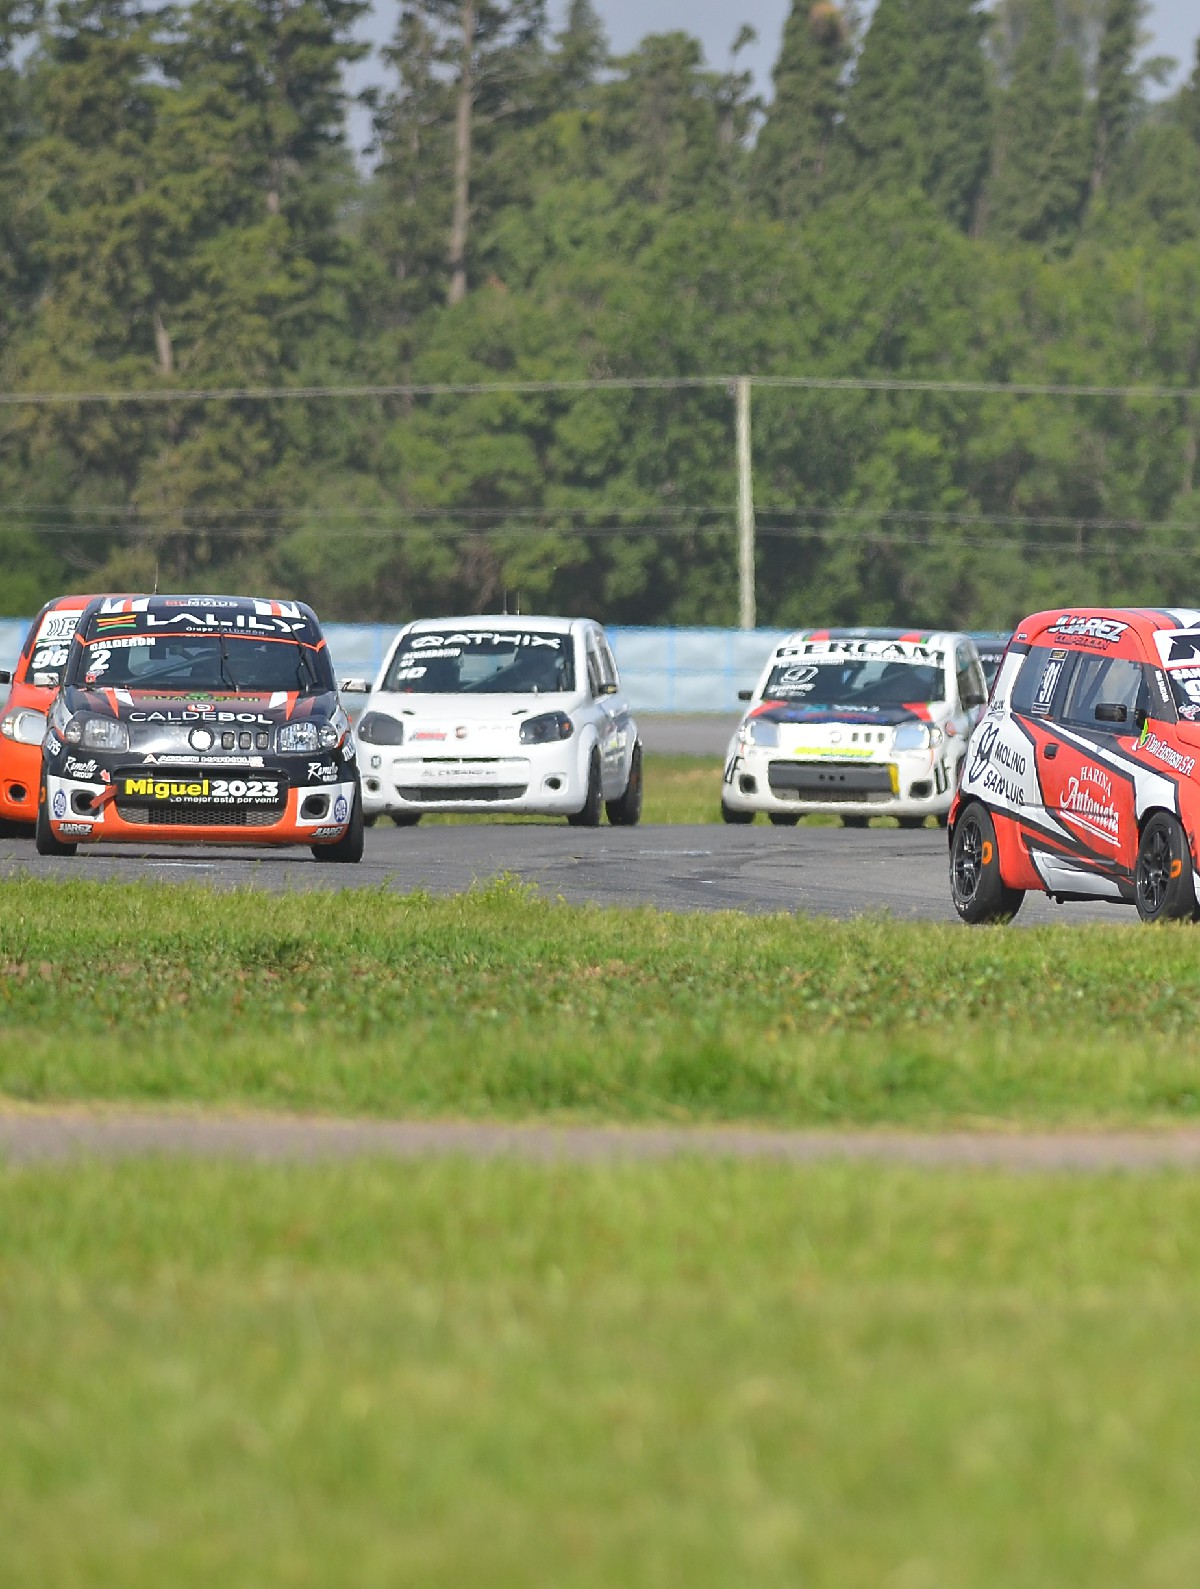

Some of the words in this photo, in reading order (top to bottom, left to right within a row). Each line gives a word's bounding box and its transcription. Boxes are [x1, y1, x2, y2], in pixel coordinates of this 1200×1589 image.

[147, 613, 305, 633] LALILY
[1048, 615, 1129, 643] JUAREZ
[32, 649, 69, 669] 96
[89, 650, 111, 671] 2
[129, 711, 274, 724] CALDEBOL
[994, 741, 1026, 776] MOLINO
[125, 778, 209, 798] Miguel
[211, 780, 279, 797] 2023
[1081, 766, 1112, 797] HARINA
[184, 796, 212, 804] mejor
